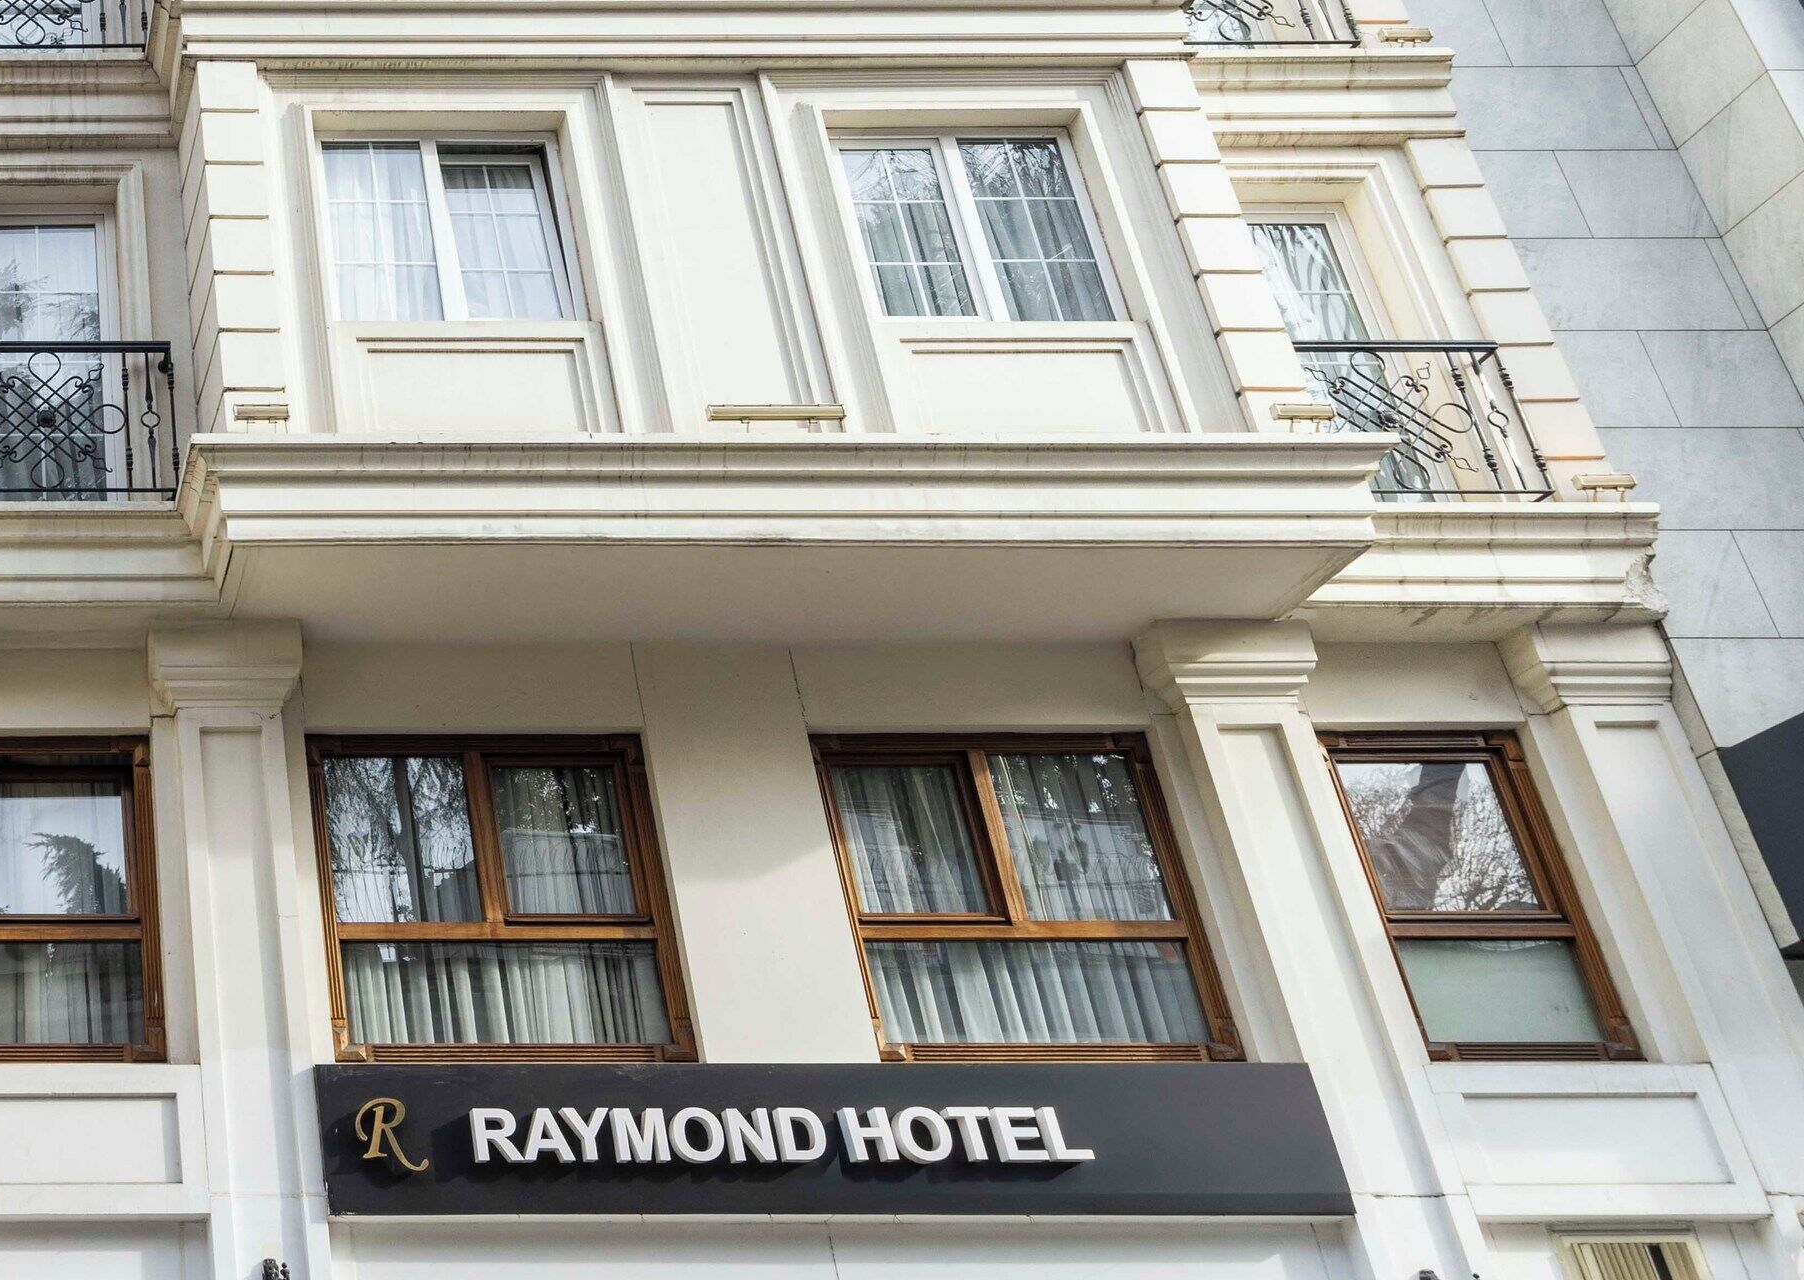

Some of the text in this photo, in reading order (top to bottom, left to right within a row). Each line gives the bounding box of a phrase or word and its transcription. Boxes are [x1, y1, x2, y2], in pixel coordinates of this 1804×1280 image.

[355, 1097, 429, 1173] R
[468, 1106, 1095, 1164] RAYMOND HOTEL
